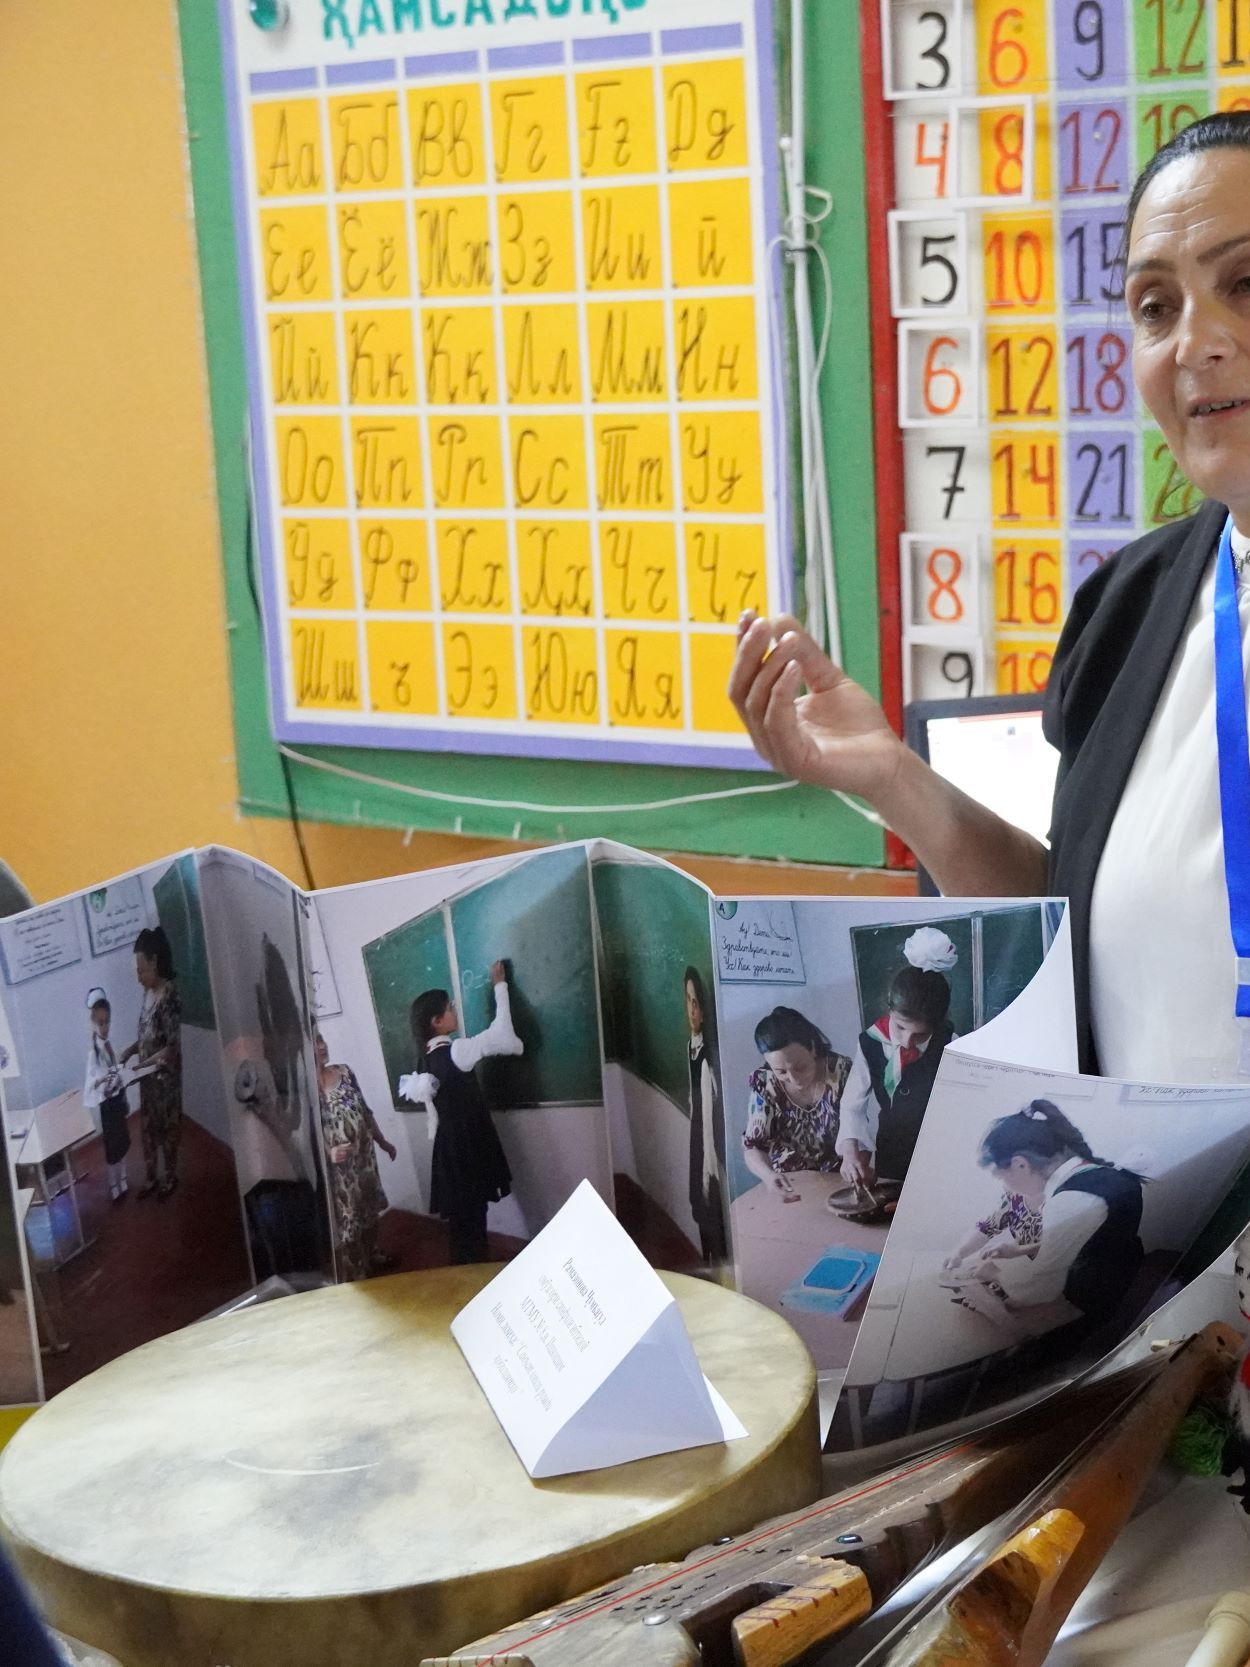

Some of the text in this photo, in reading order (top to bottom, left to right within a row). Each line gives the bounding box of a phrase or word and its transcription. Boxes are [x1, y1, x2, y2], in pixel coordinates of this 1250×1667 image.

[916, 11, 951, 89] 3
[989, 8, 1029, 88] 6
[1074, 0, 1104, 81] 9
[1144, 0, 1205, 76] 12
[914, 122, 949, 198] 4
[994, 113, 1024, 195] 8
[1061, 109, 1121, 193] 12
[921, 235, 958, 308] 5
[985, 230, 1043, 308] 10
[1066, 221, 1126, 306] 15
[922, 337, 962, 416] 6
[991, 337, 1051, 416] 12
[1066, 333, 1126, 414] 18
[925, 446, 967, 519] 7
[993, 444, 1056, 521] 14
[1075, 443, 1132, 522] 21
[926, 548, 964, 623] 8
[996, 542, 1058, 626] 16
